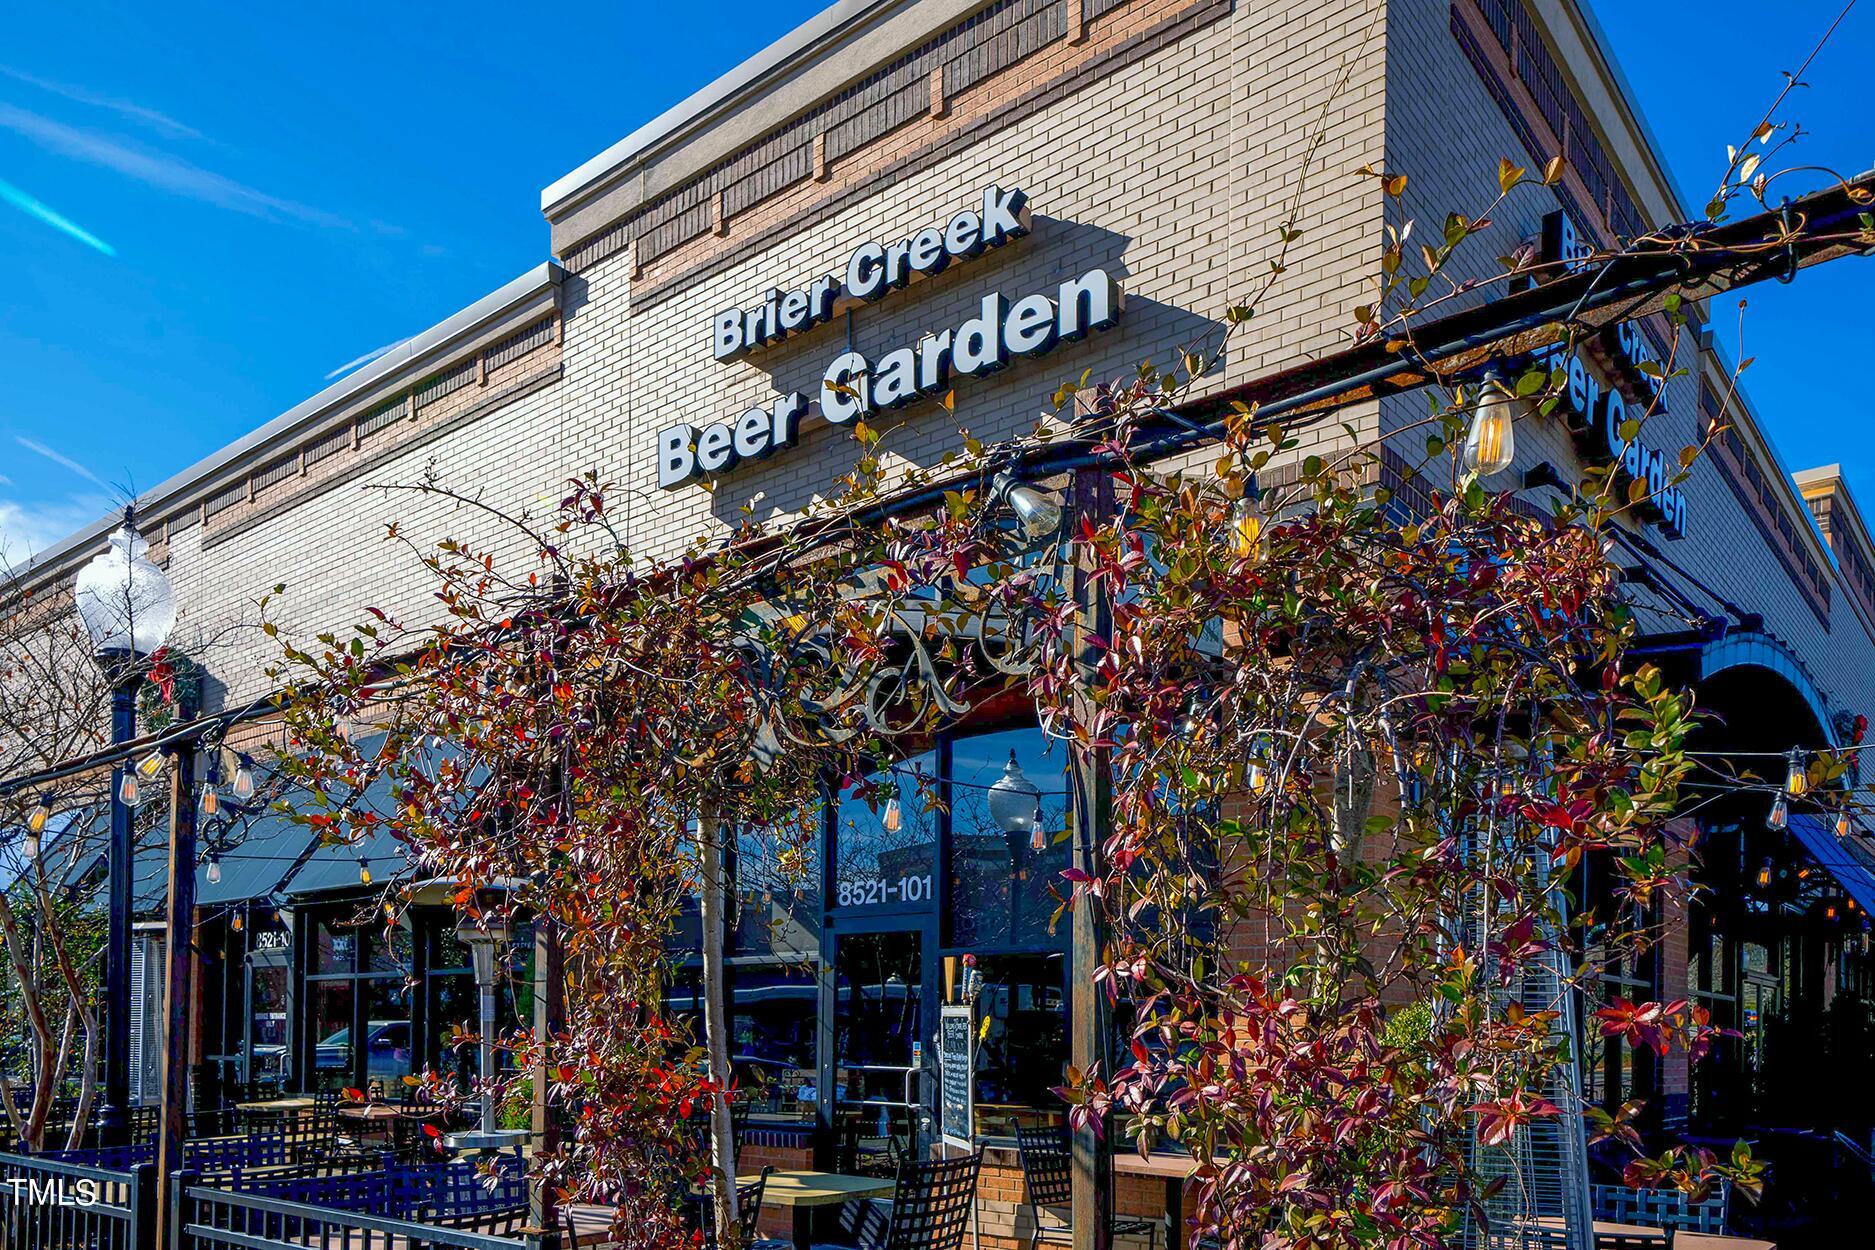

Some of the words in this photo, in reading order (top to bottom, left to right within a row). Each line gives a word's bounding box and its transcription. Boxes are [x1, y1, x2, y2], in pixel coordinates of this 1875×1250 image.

[714, 275, 833, 362] Brier
[846, 184, 1028, 298] Creek
[658, 391, 799, 489] Beer
[820, 268, 1115, 424] Garden
[838, 875, 932, 906] 8521-101
